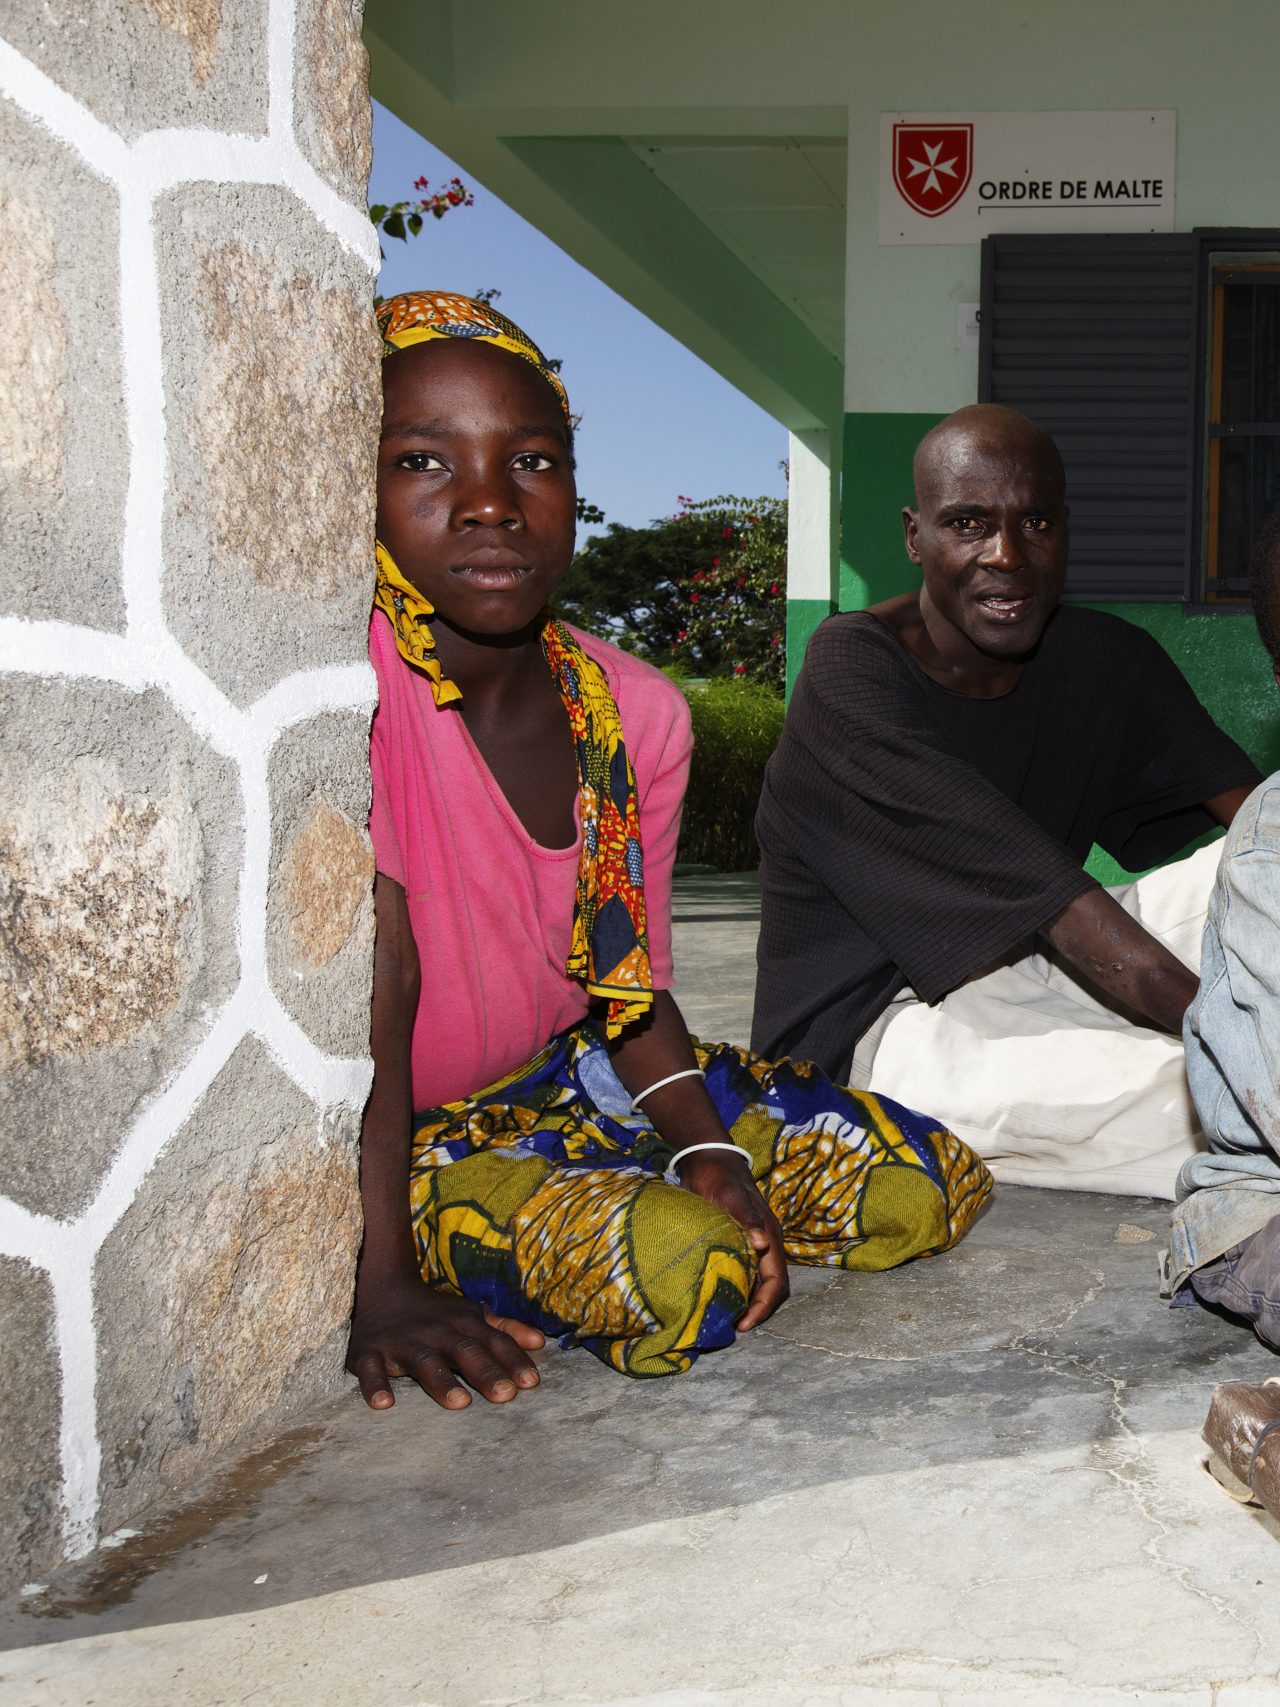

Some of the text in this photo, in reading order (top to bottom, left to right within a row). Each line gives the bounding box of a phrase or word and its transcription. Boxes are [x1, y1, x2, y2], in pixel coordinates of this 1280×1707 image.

[978, 180, 1163, 200] ORDRE DE MALTE
